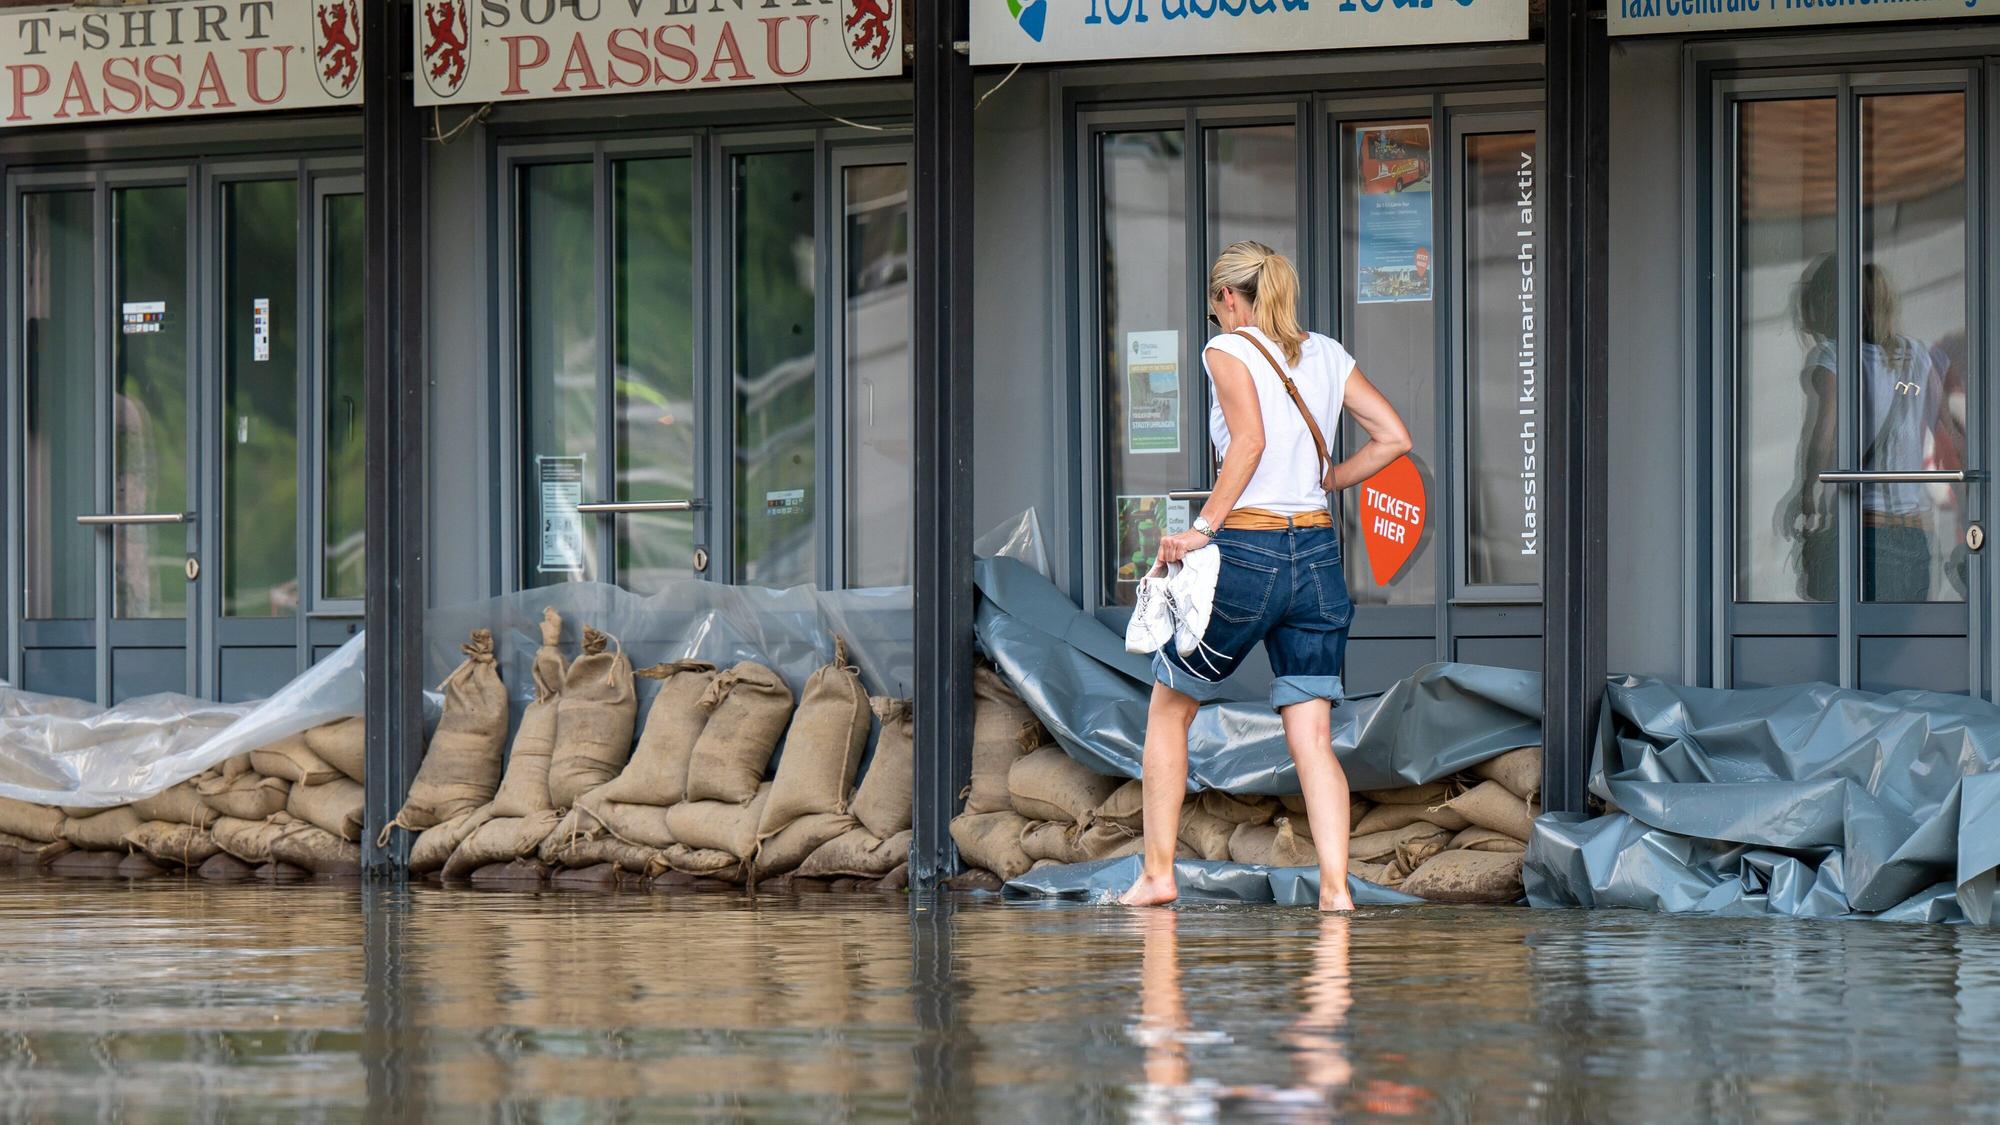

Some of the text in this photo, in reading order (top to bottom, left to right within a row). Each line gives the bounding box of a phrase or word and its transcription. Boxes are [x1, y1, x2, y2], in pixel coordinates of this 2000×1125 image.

[18, 1, 274, 55] T-SHIRT
[500, 15, 820, 96] PASSAU
[5, 45, 295, 121] PASSAU
[1517, 151, 1532, 224] aktiv
[1517, 243, 1535, 402] kulinarisch
[1366, 487, 1421, 525] TICKETS
[1519, 421, 1537, 555] klassisch
[1373, 515, 1406, 544] HIER
